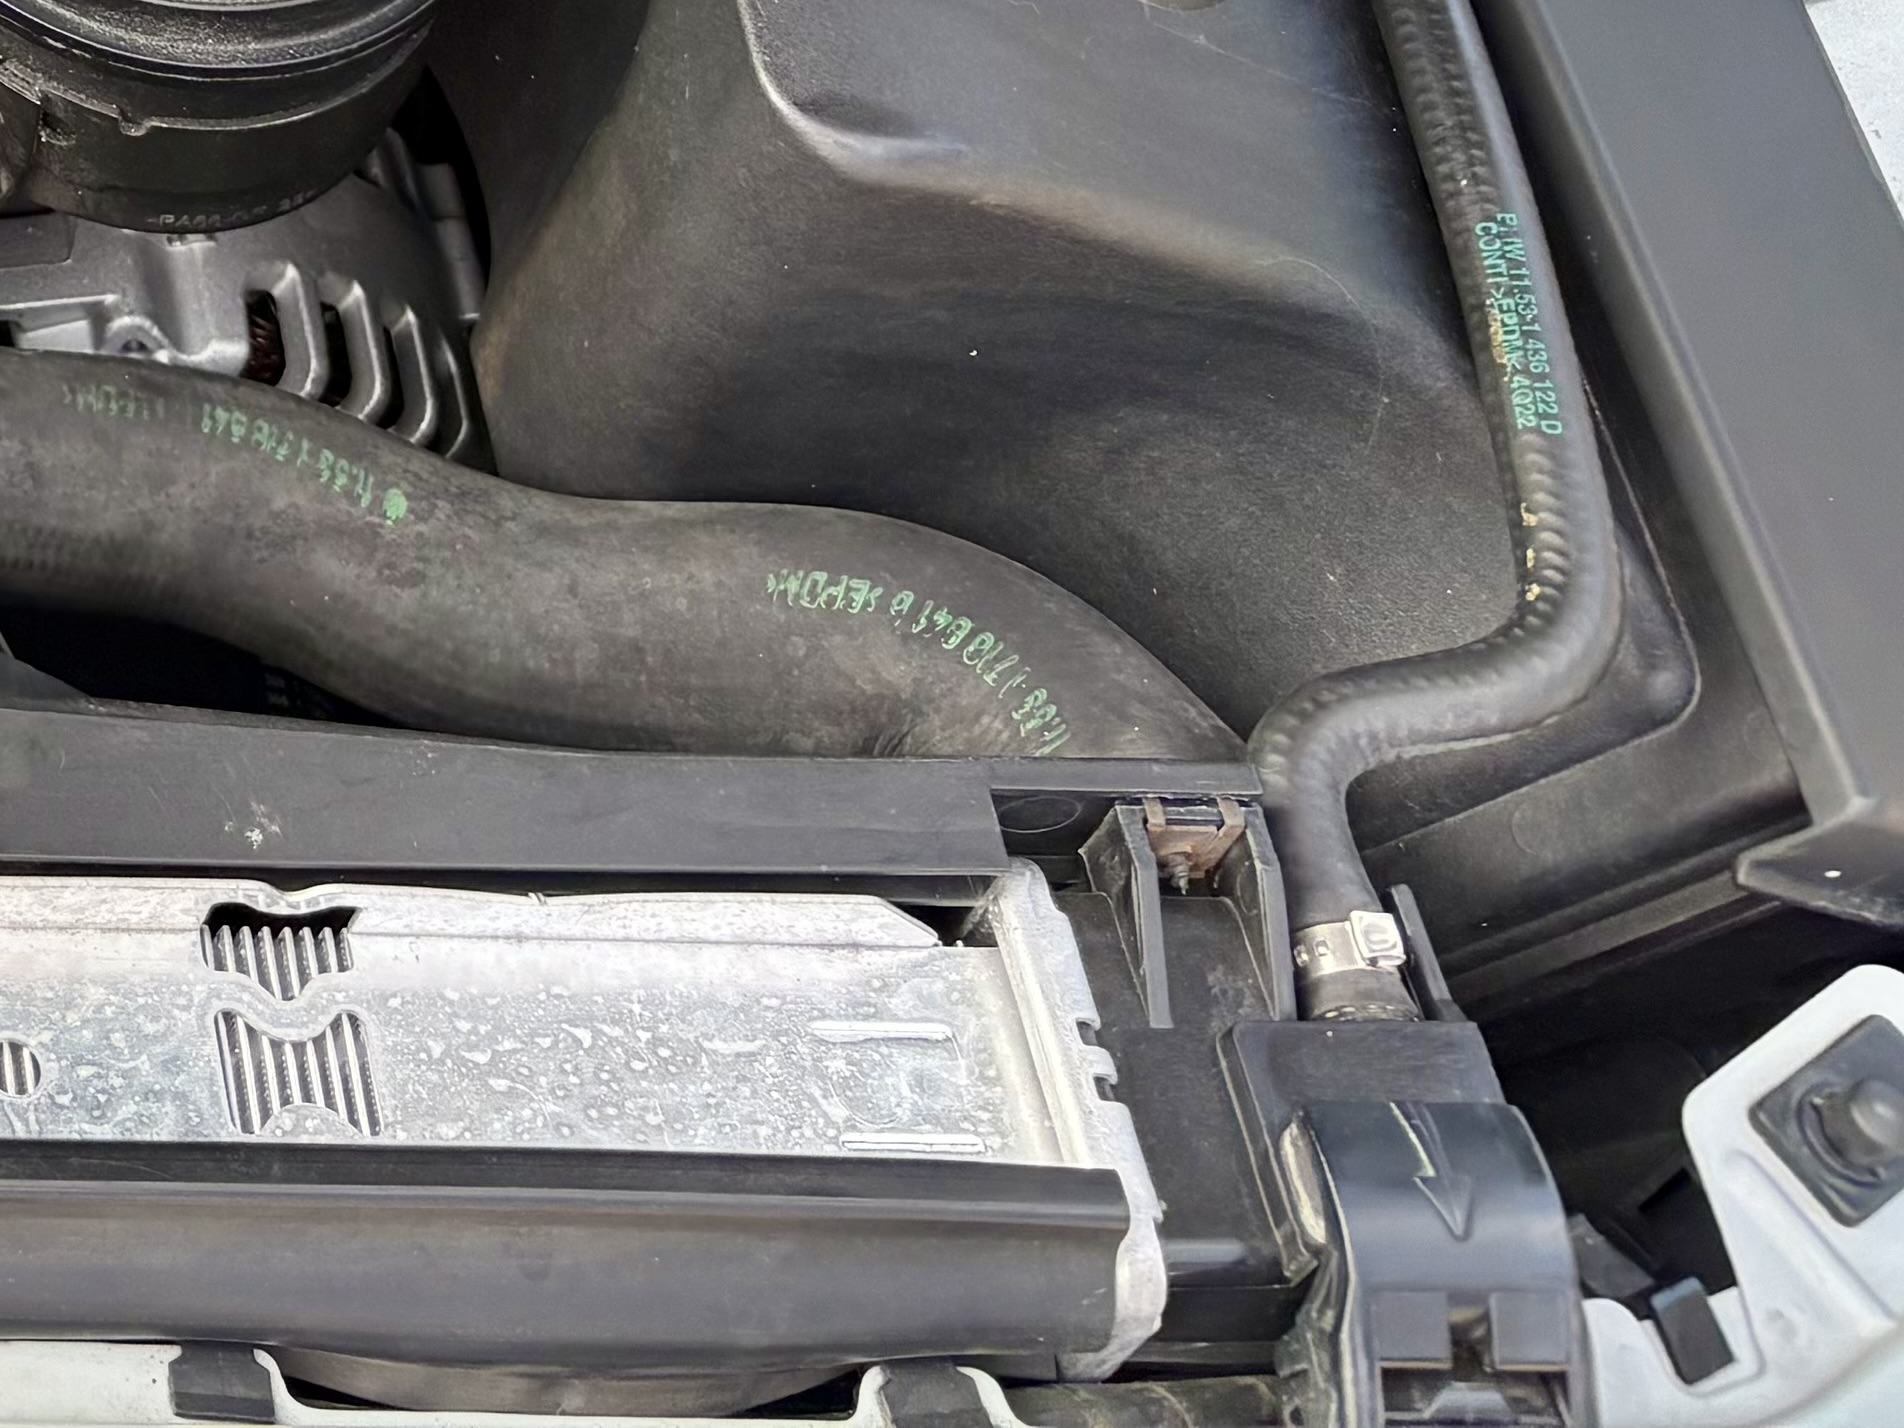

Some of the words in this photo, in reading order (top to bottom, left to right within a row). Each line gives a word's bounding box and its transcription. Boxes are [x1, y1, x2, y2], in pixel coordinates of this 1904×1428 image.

[1474, 221, 1509, 285] CONTI
[1509, 375, 1536, 430] 4Q22
[1525, 338, 1551, 374] 436
[1533, 378, 1560, 416] 122
